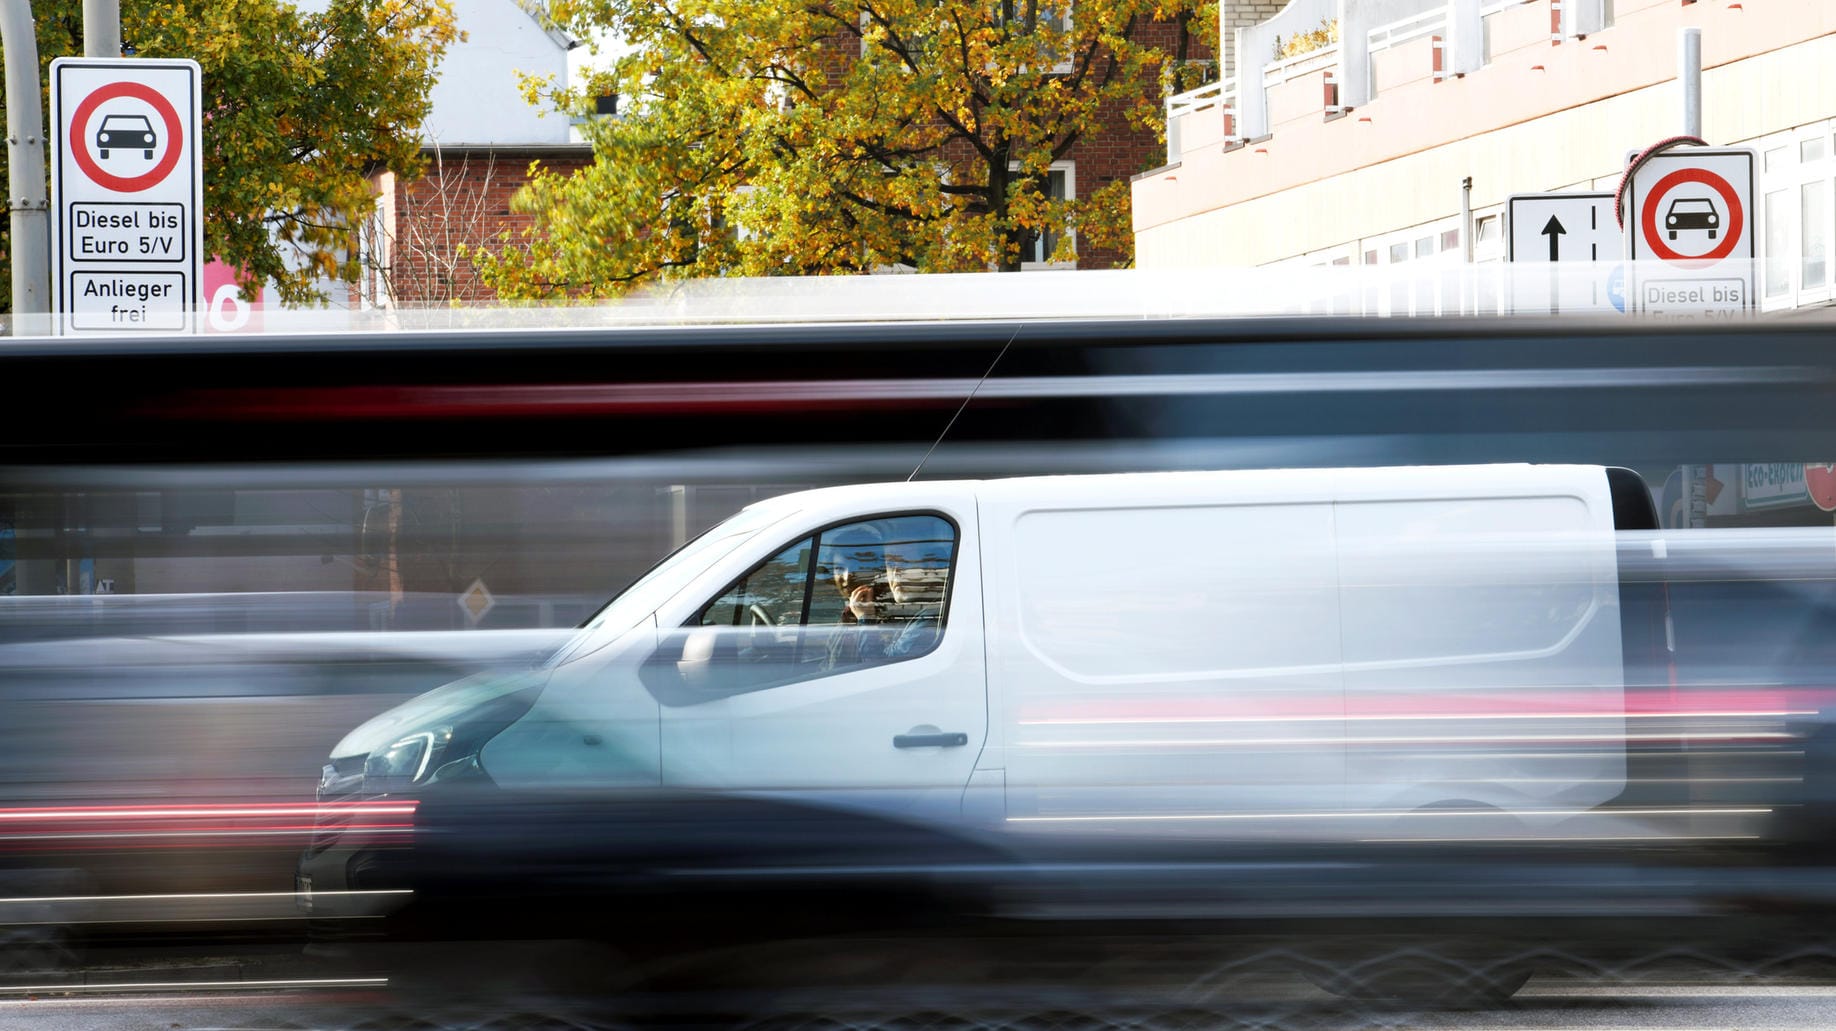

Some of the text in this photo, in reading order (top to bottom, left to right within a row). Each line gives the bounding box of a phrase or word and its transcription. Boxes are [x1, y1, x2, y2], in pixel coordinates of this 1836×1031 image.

[77, 210, 178, 229] Diesel bis
[82, 236, 173, 254] Euro 5/V
[84, 279, 172, 301] Anlieger
[1648, 286, 1740, 304] Diesel bis
[111, 305, 146, 323] frei
